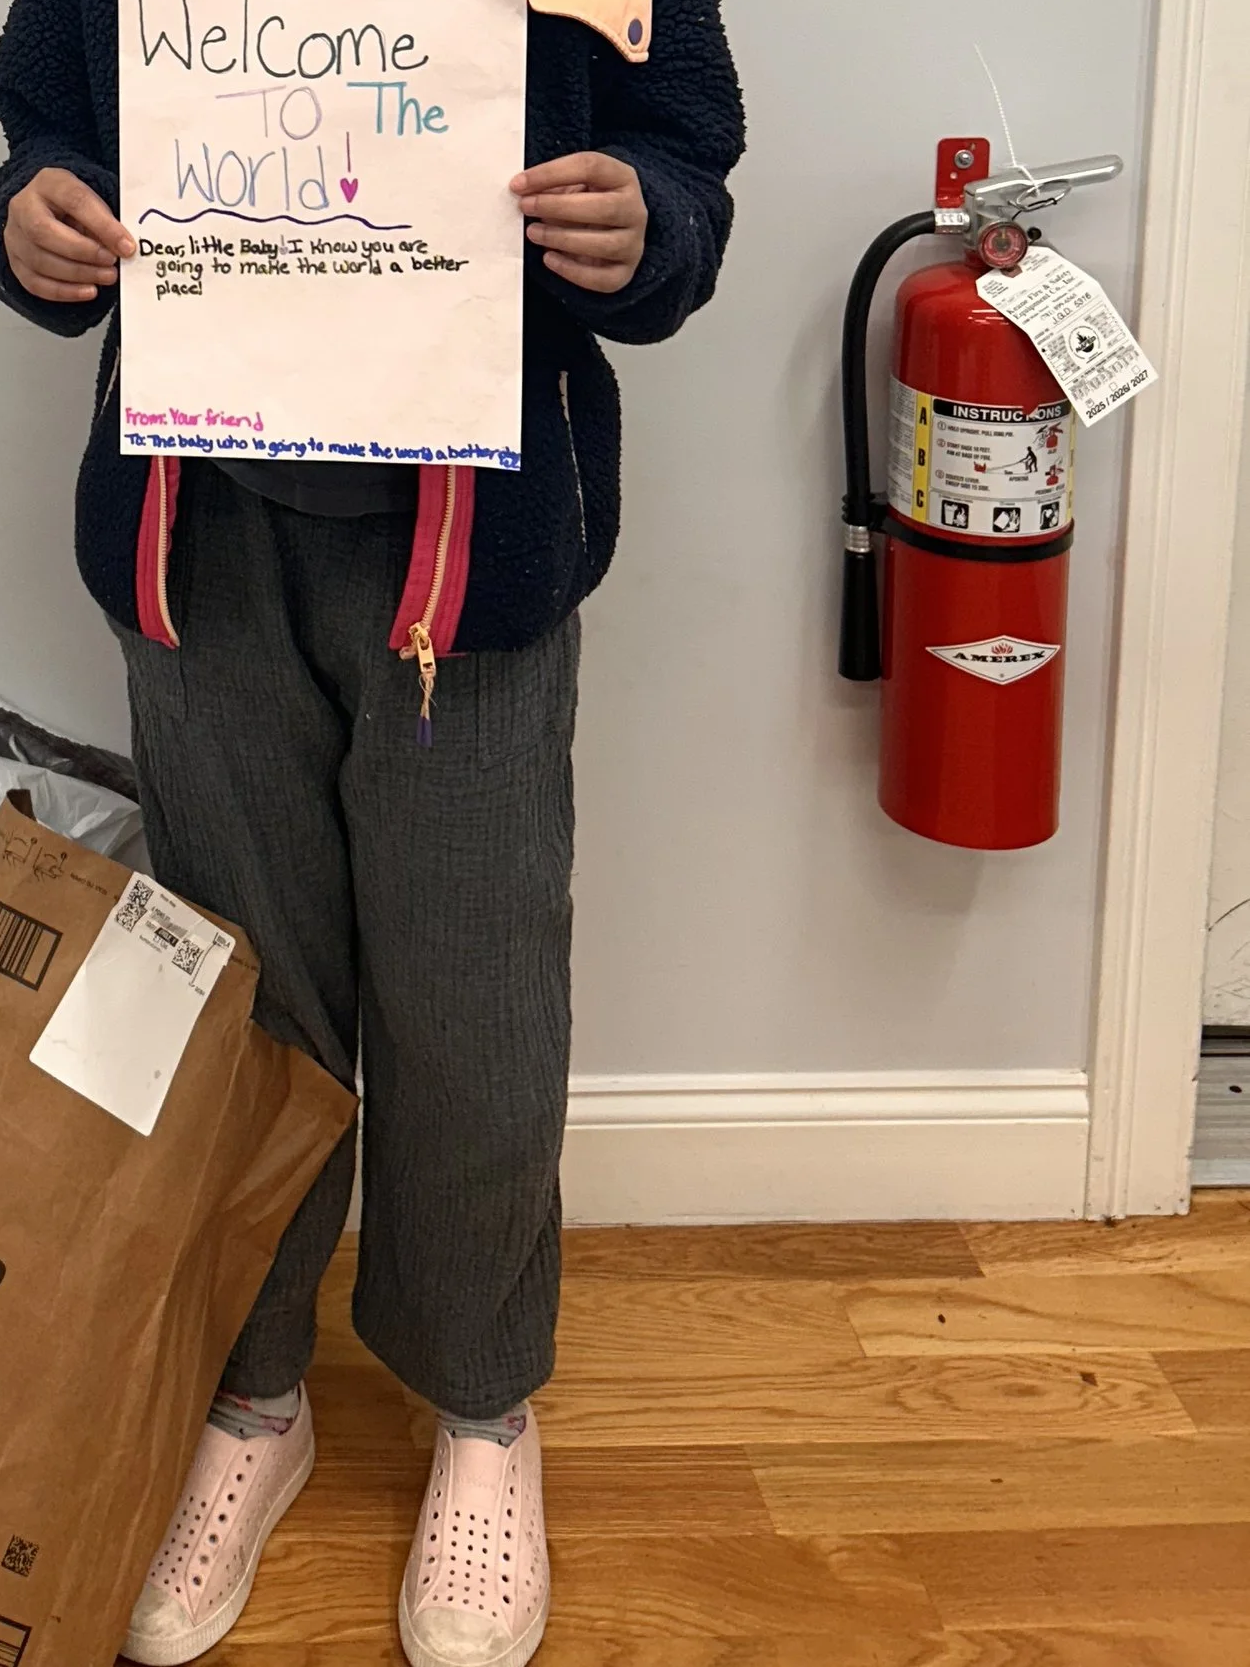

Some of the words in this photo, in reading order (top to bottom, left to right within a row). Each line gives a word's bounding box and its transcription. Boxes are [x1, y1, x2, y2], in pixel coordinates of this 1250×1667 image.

[215, 85, 322, 141] TO
[347, 81, 449, 136] The
[139, 238, 186, 257] Dear,
[189, 235, 235, 256] little
[288, 239, 303, 254] I
[361, 240, 395, 258] you
[400, 239, 428, 254] are
[156, 260, 204, 281] going
[211, 257, 231, 274] to
[297, 257, 327, 275] the
[332, 258, 383, 275] world
[390, 261, 404, 273] a
[411, 255, 469, 272] better
[156, 281, 203, 301] place!
[1086, 401, 1106, 419] 2025
[1131, 369, 1149, 387] 2027
[205, 408, 264, 432] friend
[919, 407, 927, 425] A
[953, 405, 1062, 422] INSTRUCONS
[147, 434, 176, 448] The
[178, 434, 213, 453] baby
[217, 435, 248, 450] who
[268, 439, 307, 458] going
[308, 437, 324, 452] to
[369, 441, 393, 459] the
[435, 450, 448, 460] a
[447, 443, 499, 460] better
[918, 448, 926, 466] B
[916, 489, 924, 508] C
[953, 650, 1046, 663] AMEREX
